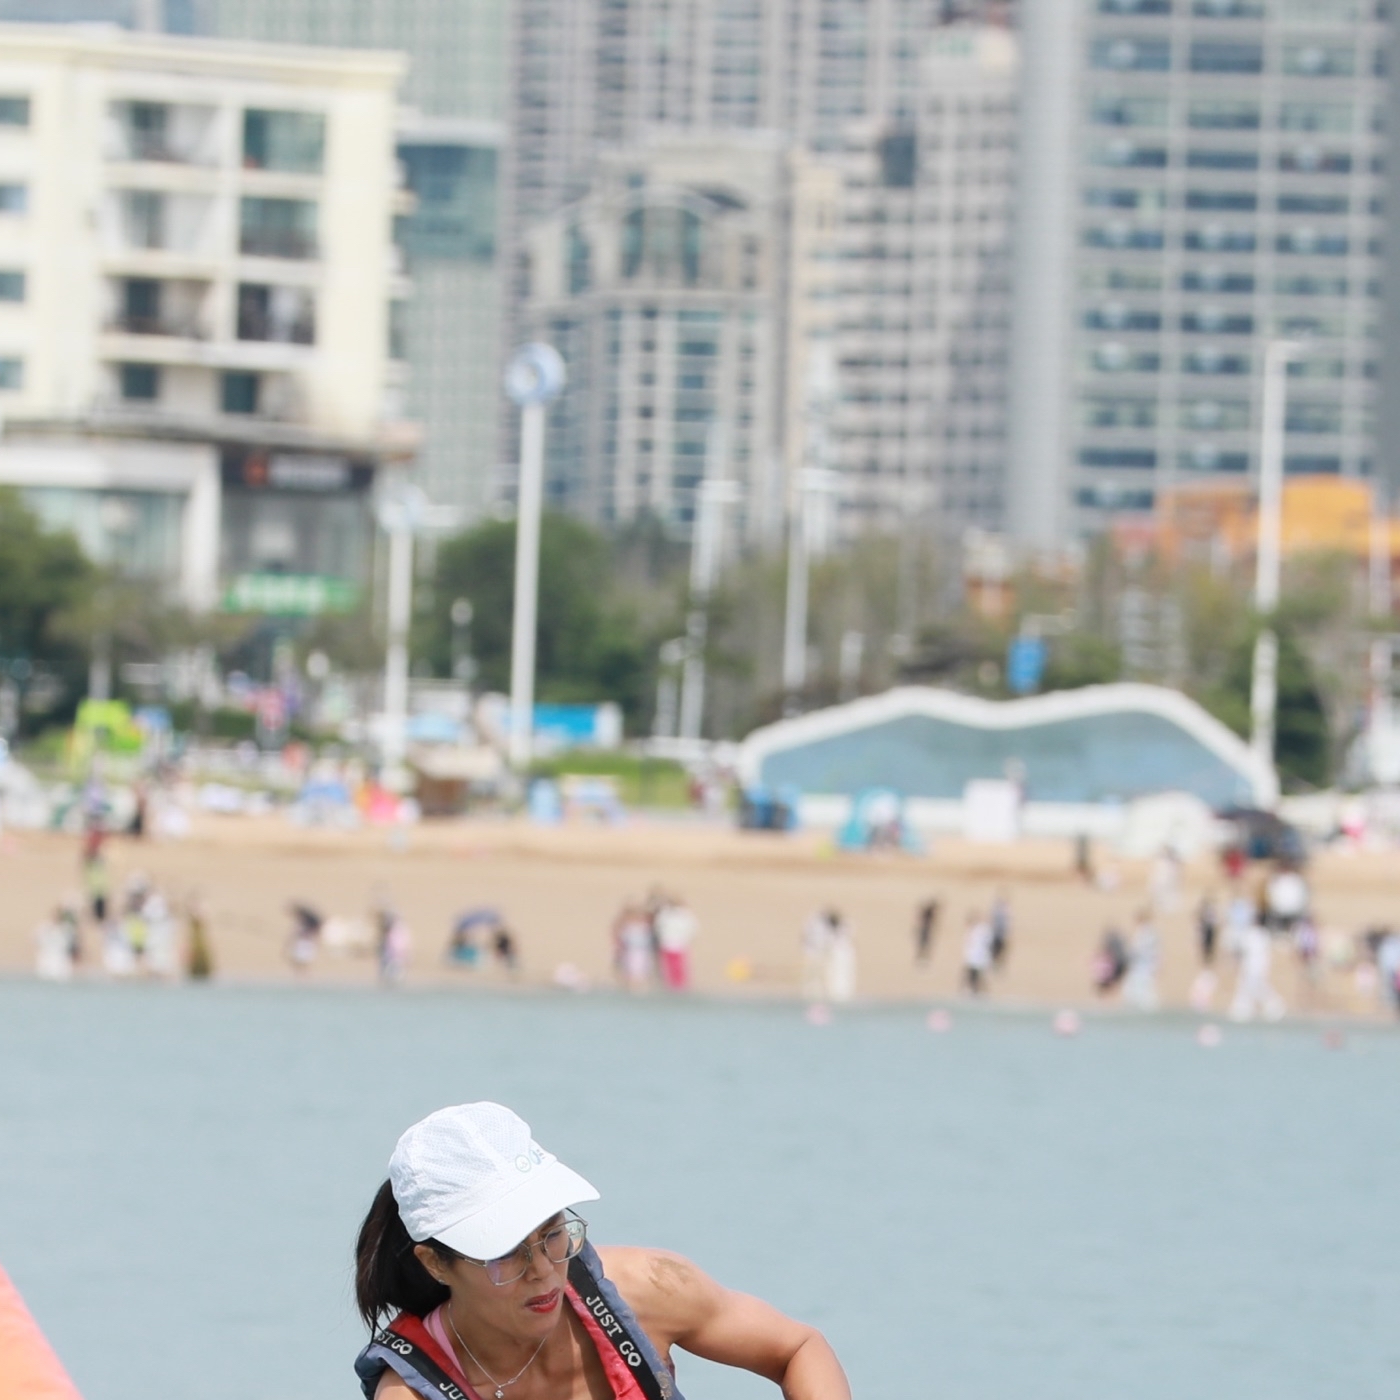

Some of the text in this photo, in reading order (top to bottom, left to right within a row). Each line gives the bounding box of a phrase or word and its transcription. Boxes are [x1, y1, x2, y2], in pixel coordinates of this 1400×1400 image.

[391, 1338, 413, 1355] GO
[586, 1296, 642, 1367] JUST GO
